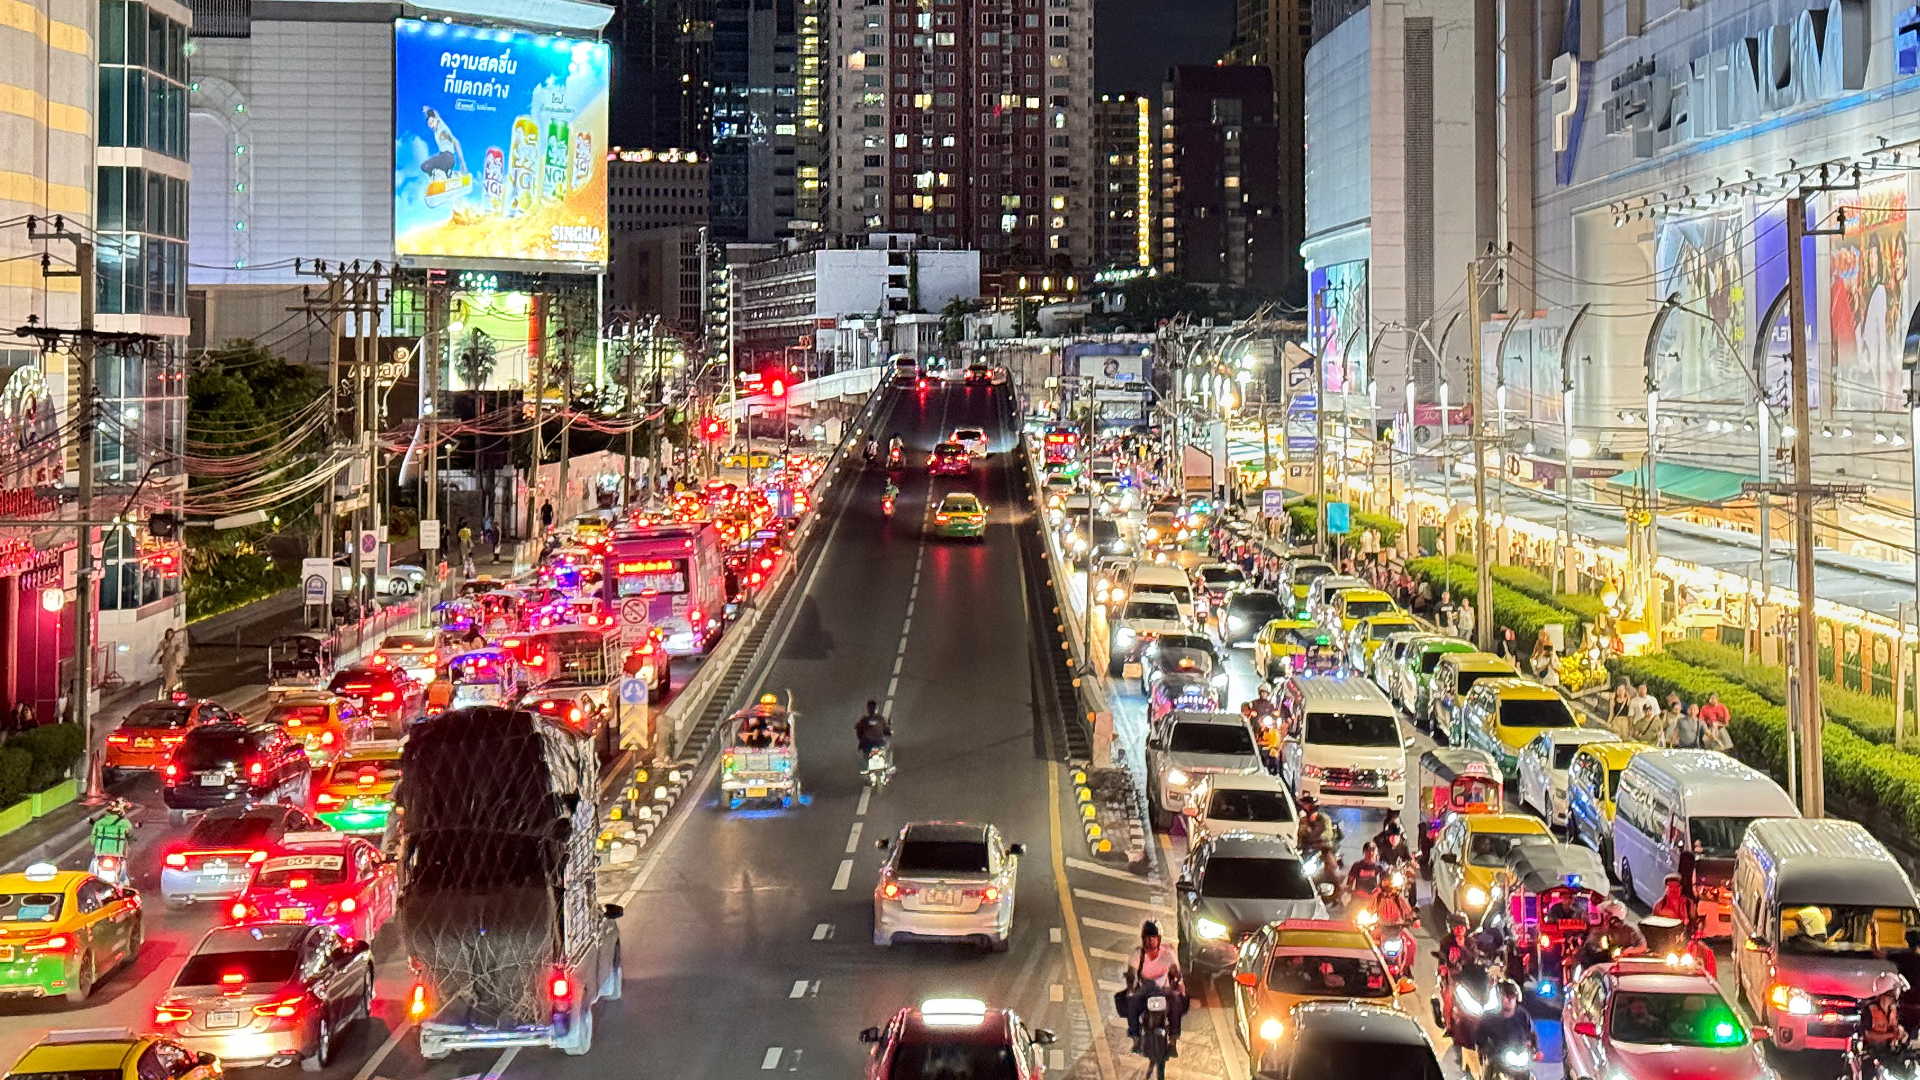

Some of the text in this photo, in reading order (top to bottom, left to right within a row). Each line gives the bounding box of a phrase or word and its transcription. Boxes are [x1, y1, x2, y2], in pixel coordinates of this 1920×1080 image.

[440, 48, 517, 75] ความสดชื่น
[444, 69, 510, 99] ที่แตกต่าง
[1632, 0, 1871, 158] PLATINUM
[551, 225, 600, 243] SINGHA
